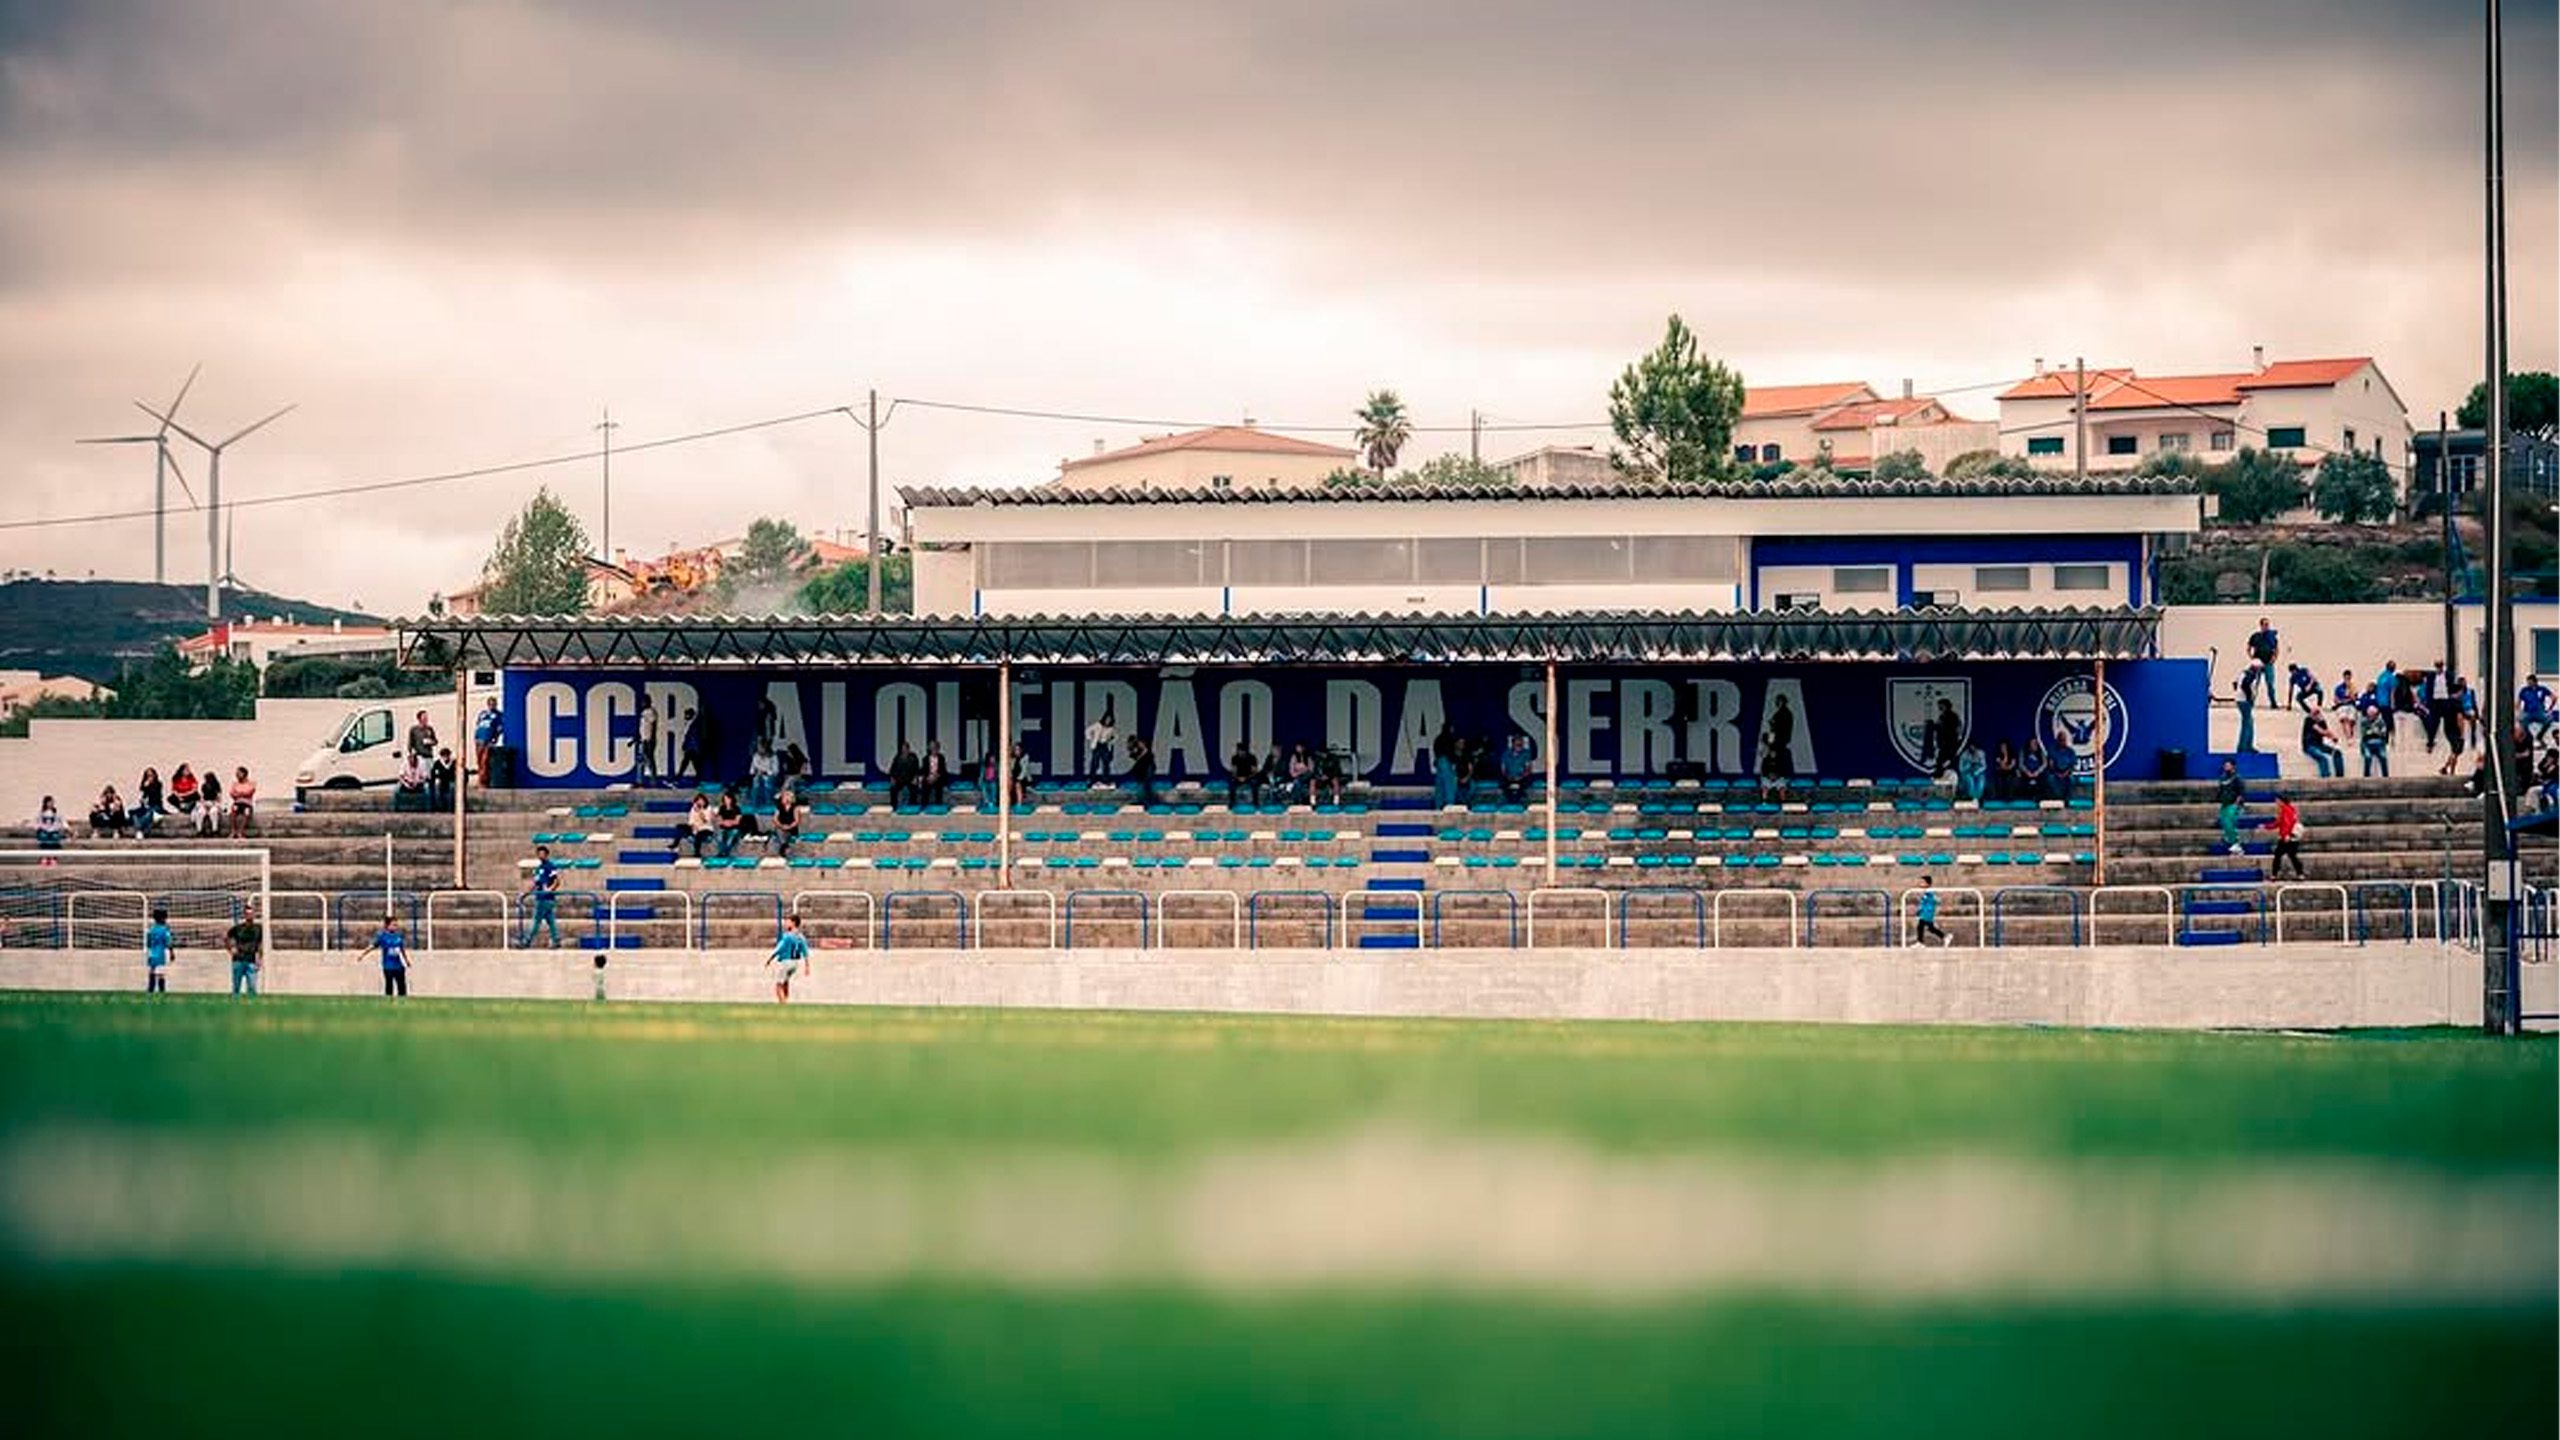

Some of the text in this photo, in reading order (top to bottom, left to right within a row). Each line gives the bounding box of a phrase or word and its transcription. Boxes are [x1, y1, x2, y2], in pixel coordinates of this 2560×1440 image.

[526, 681, 701, 777] CCR
[1327, 679, 1453, 776] DA
[1507, 678, 1819, 775] SERRA
